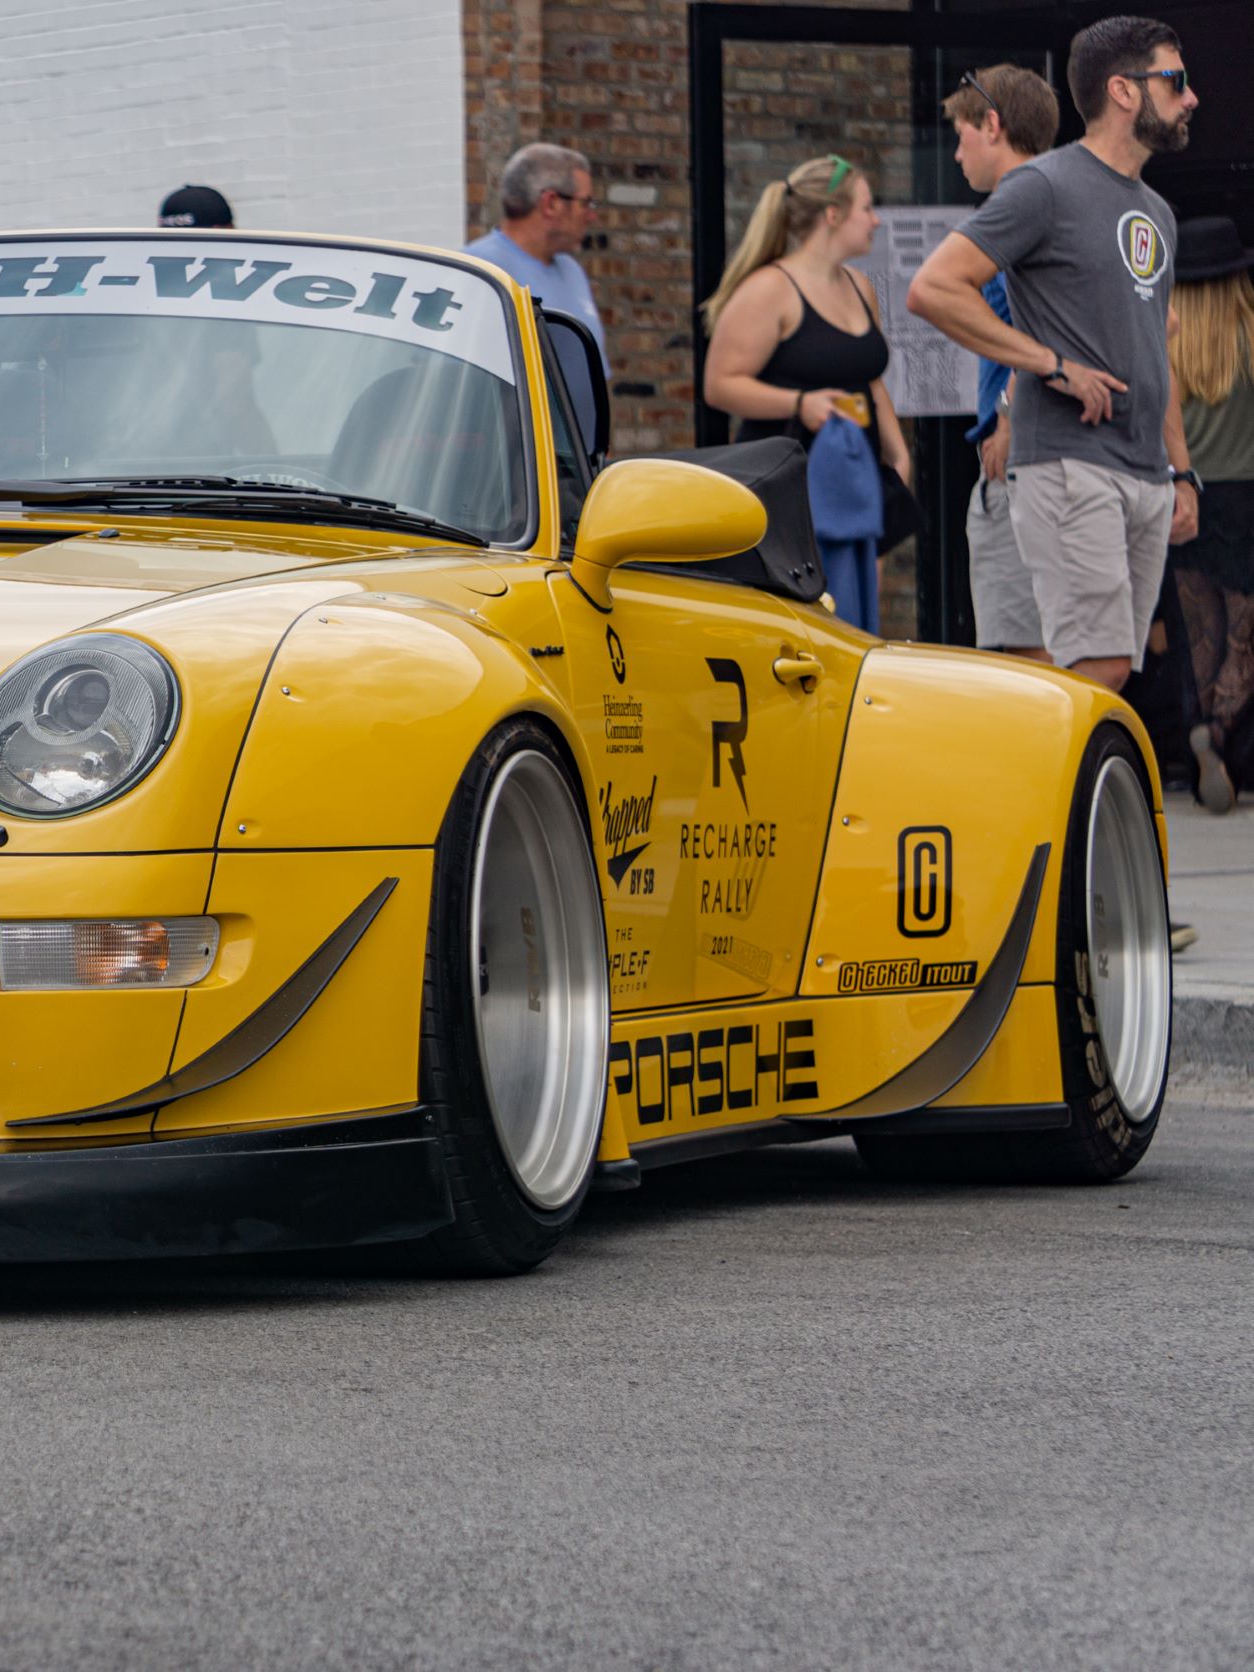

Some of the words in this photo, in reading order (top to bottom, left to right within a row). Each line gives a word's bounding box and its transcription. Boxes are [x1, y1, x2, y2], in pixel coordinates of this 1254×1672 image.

[605, 718, 643, 744] Community
[599, 775, 657, 858] rapped
[680, 823, 777, 859] RECHARGE
[630, 868, 642, 895] BY
[643, 868, 655, 894] SB
[700, 878, 753, 914] RALLY
[615, 928, 633, 943] THE
[710, 936, 733, 955] 2021
[612, 981, 647, 994] ECTION
[609, 1019, 819, 1126] PORSCHE
